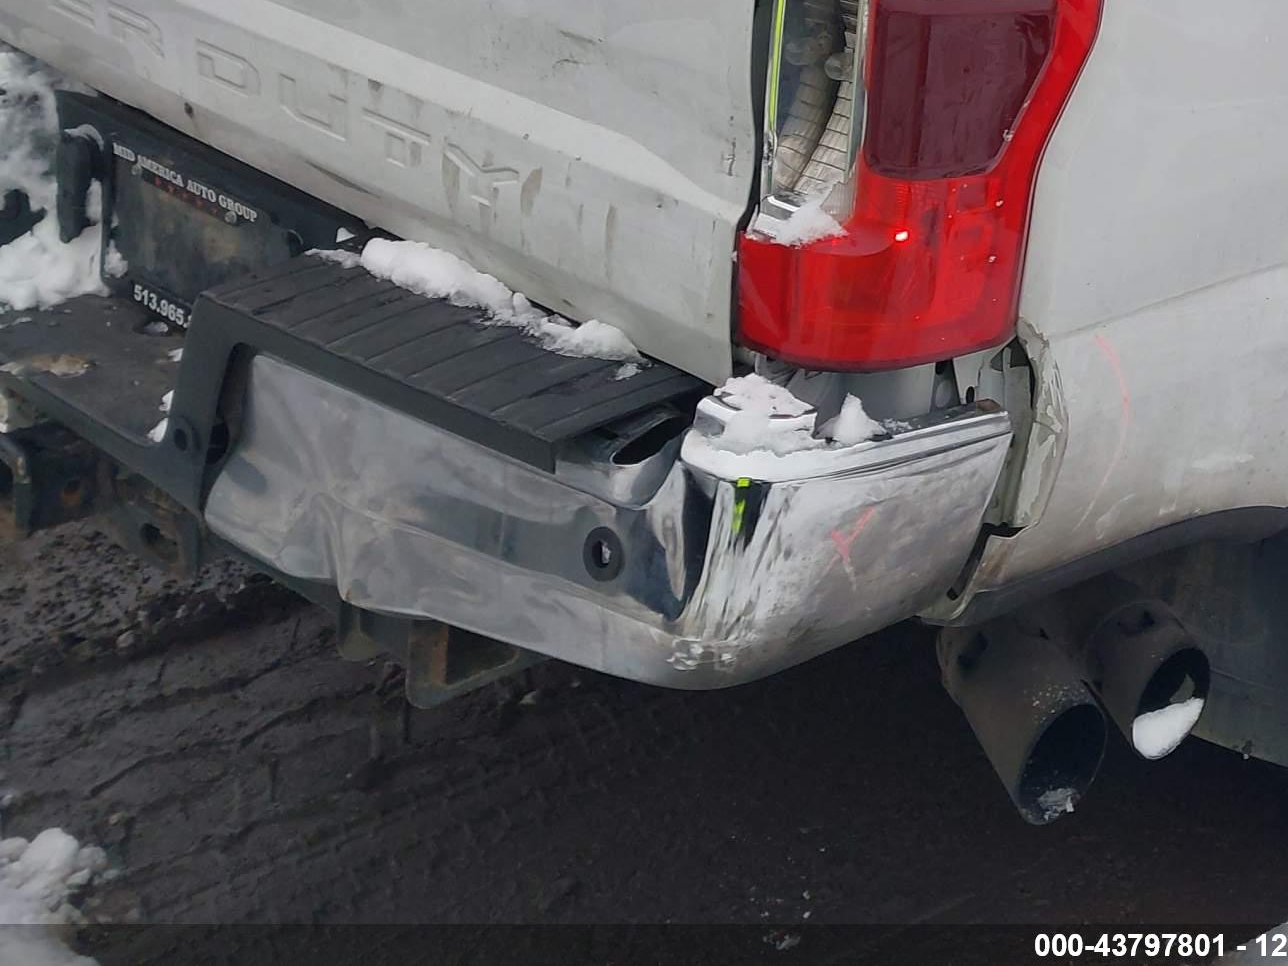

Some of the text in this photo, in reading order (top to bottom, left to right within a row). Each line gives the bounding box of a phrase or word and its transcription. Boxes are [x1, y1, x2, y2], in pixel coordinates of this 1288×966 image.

[112, 142, 258, 223] MID AMERICA AUTO GROUP
[195, 36, 520, 210] DUTY
